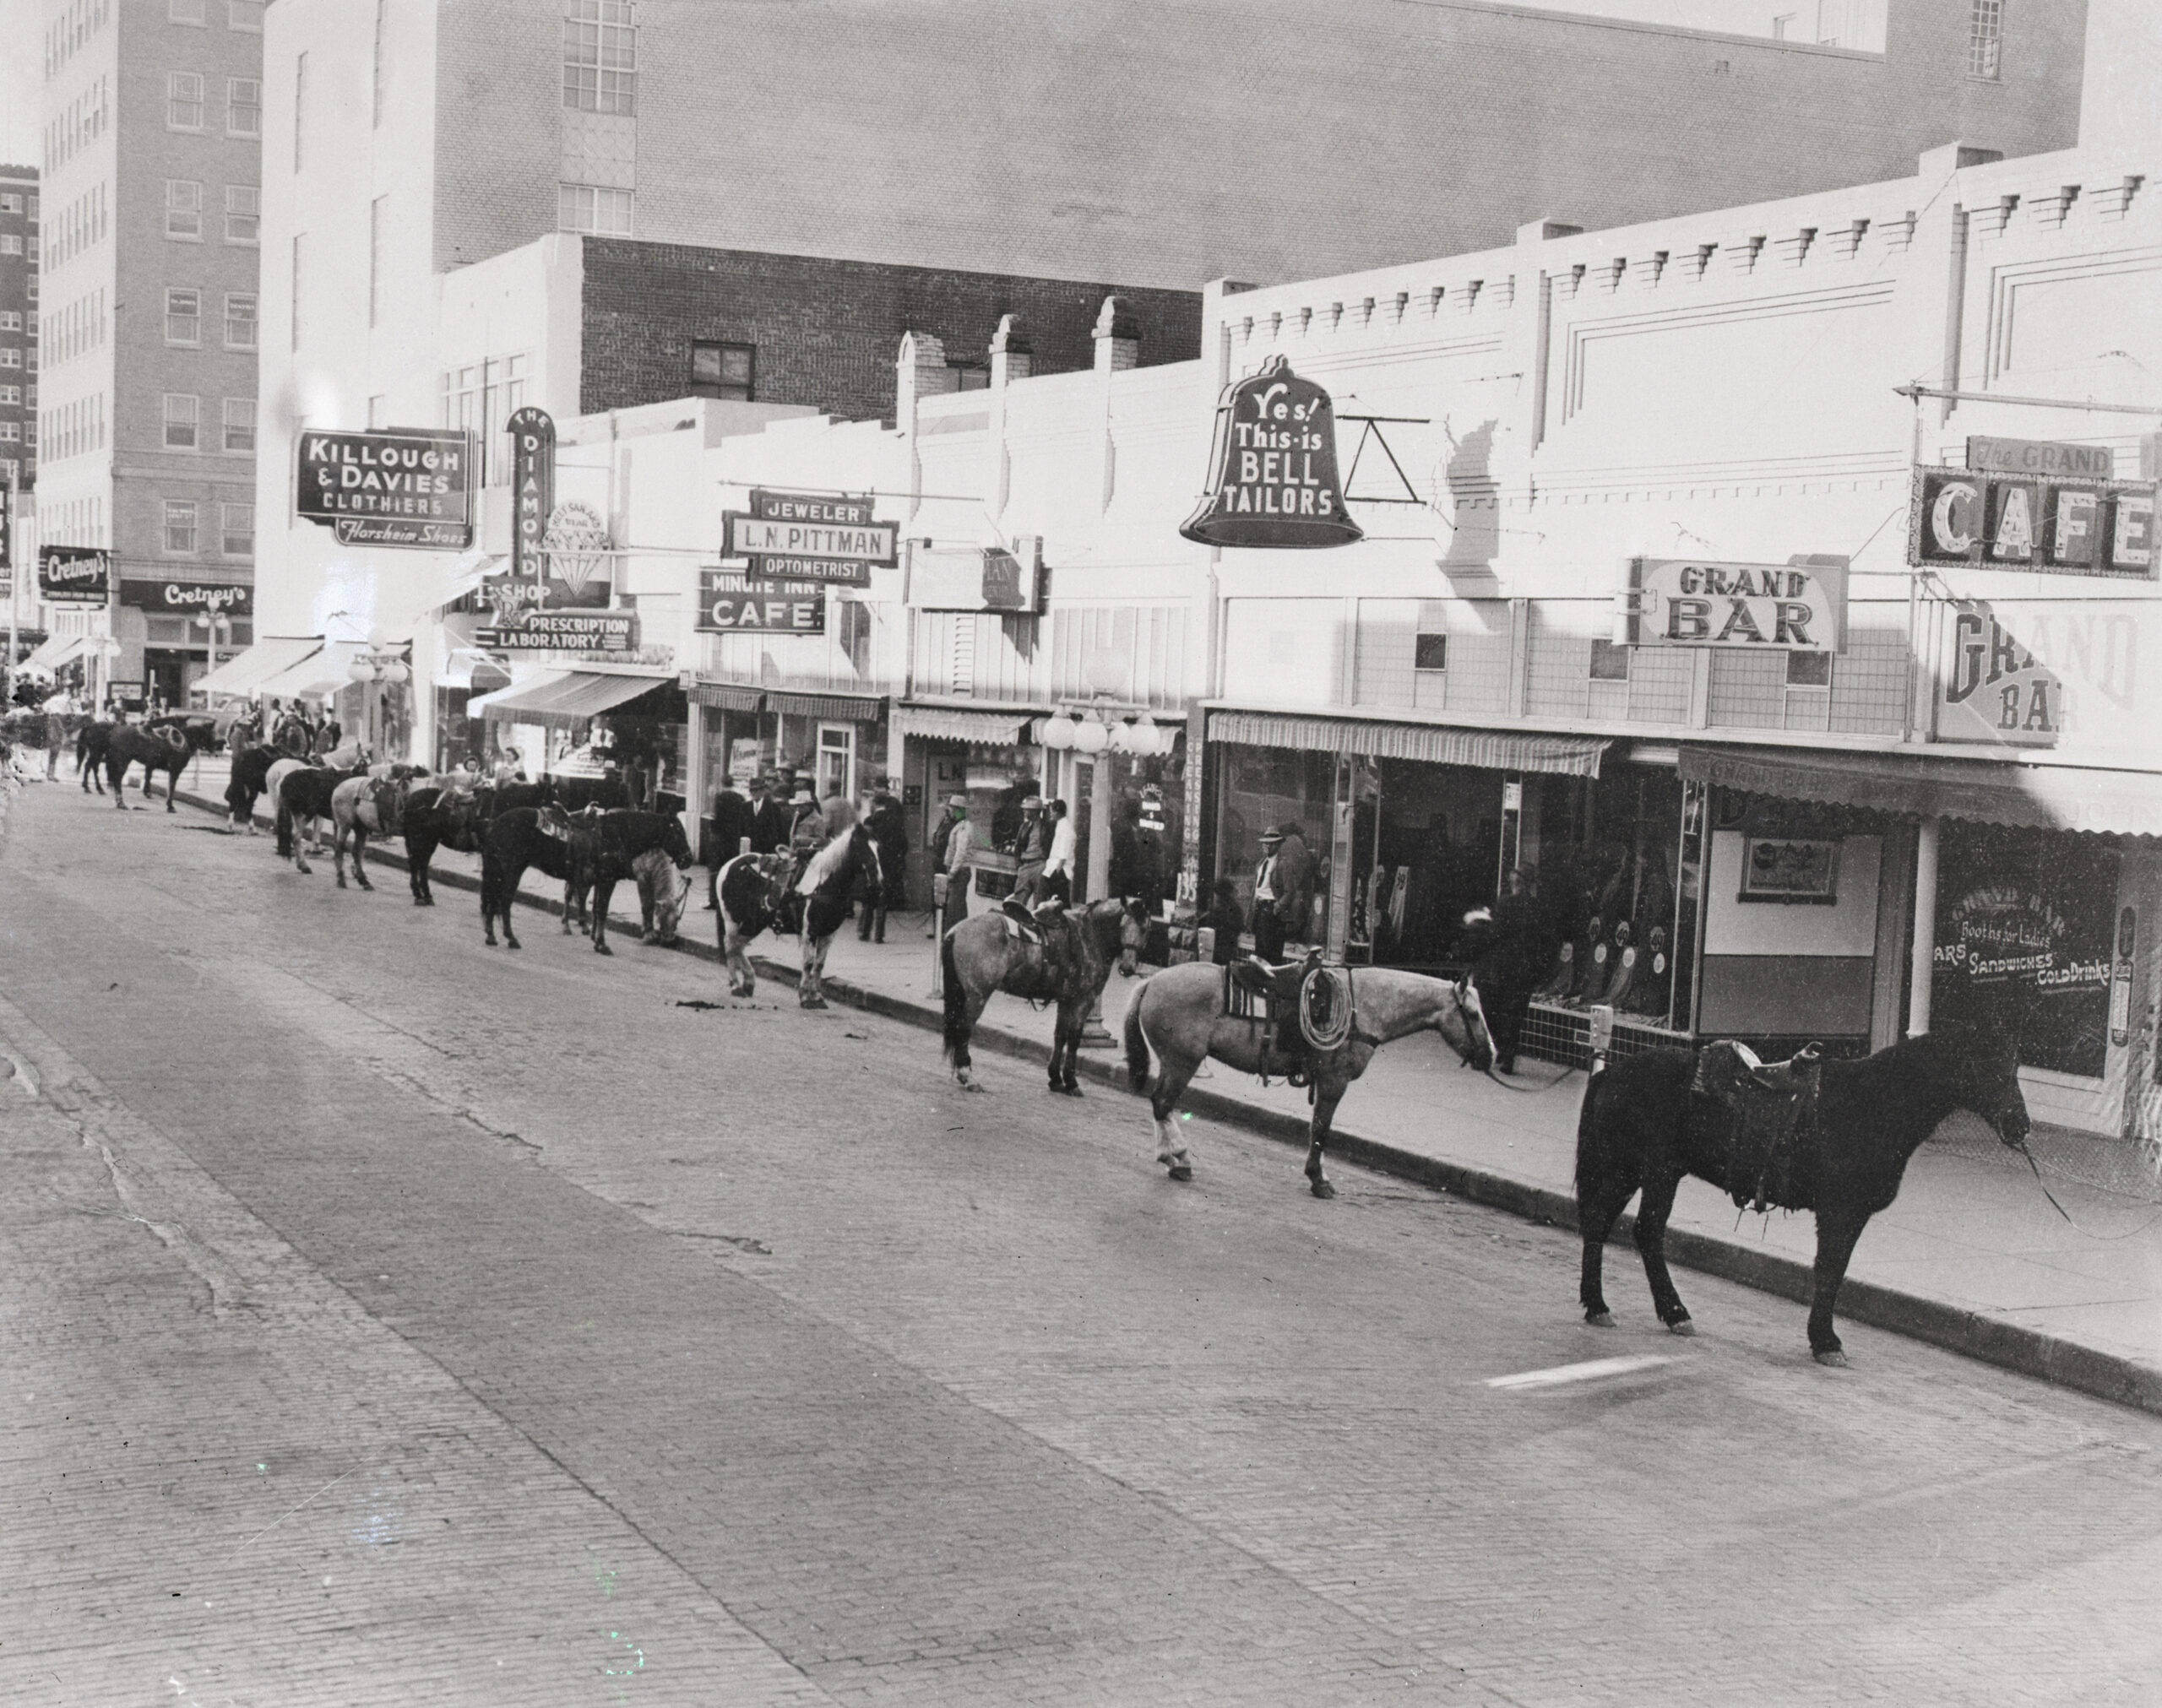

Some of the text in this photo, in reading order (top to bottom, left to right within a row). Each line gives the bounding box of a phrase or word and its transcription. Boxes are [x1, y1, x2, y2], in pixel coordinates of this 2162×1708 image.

[1253, 382, 1319, 421] Yes!
[514, 410, 548, 426] THE
[309, 438, 459, 471] KILLOUGH
[1241, 451, 1318, 485] BELL
[1975, 437, 2110, 472] The GRAND
[318, 465, 449, 494] & DAVIES
[323, 492, 442, 515] CLOTHIERS
[522, 436, 538, 575] DIAMOND
[769, 502, 860, 523] JEWELER
[1224, 485, 1332, 515] TAILORS
[419, 525, 468, 544] Shoes
[1932, 482, 2154, 564] CAFE
[789, 527, 882, 555] PITTMAN
[47, 550, 106, 583] Cretney's
[766, 558, 860, 577] OPTOMETRIST
[165, 584, 246, 606] Cretney's
[502, 583, 551, 603] SHOP
[1680, 567, 1811, 598] GRAND
[530, 617, 629, 633] PRESCRIPTION
[1664, 597, 1817, 644] BAR
[500, 632, 600, 648] LABORATORY
[1183, 740, 1193, 840] CLEANING
[1192, 740, 1203, 841] PRESSING
[1961, 921, 2002, 941] Booths
[2019, 924, 2051, 949] Ladies
[1969, 952, 2054, 974] SANDWICHES
